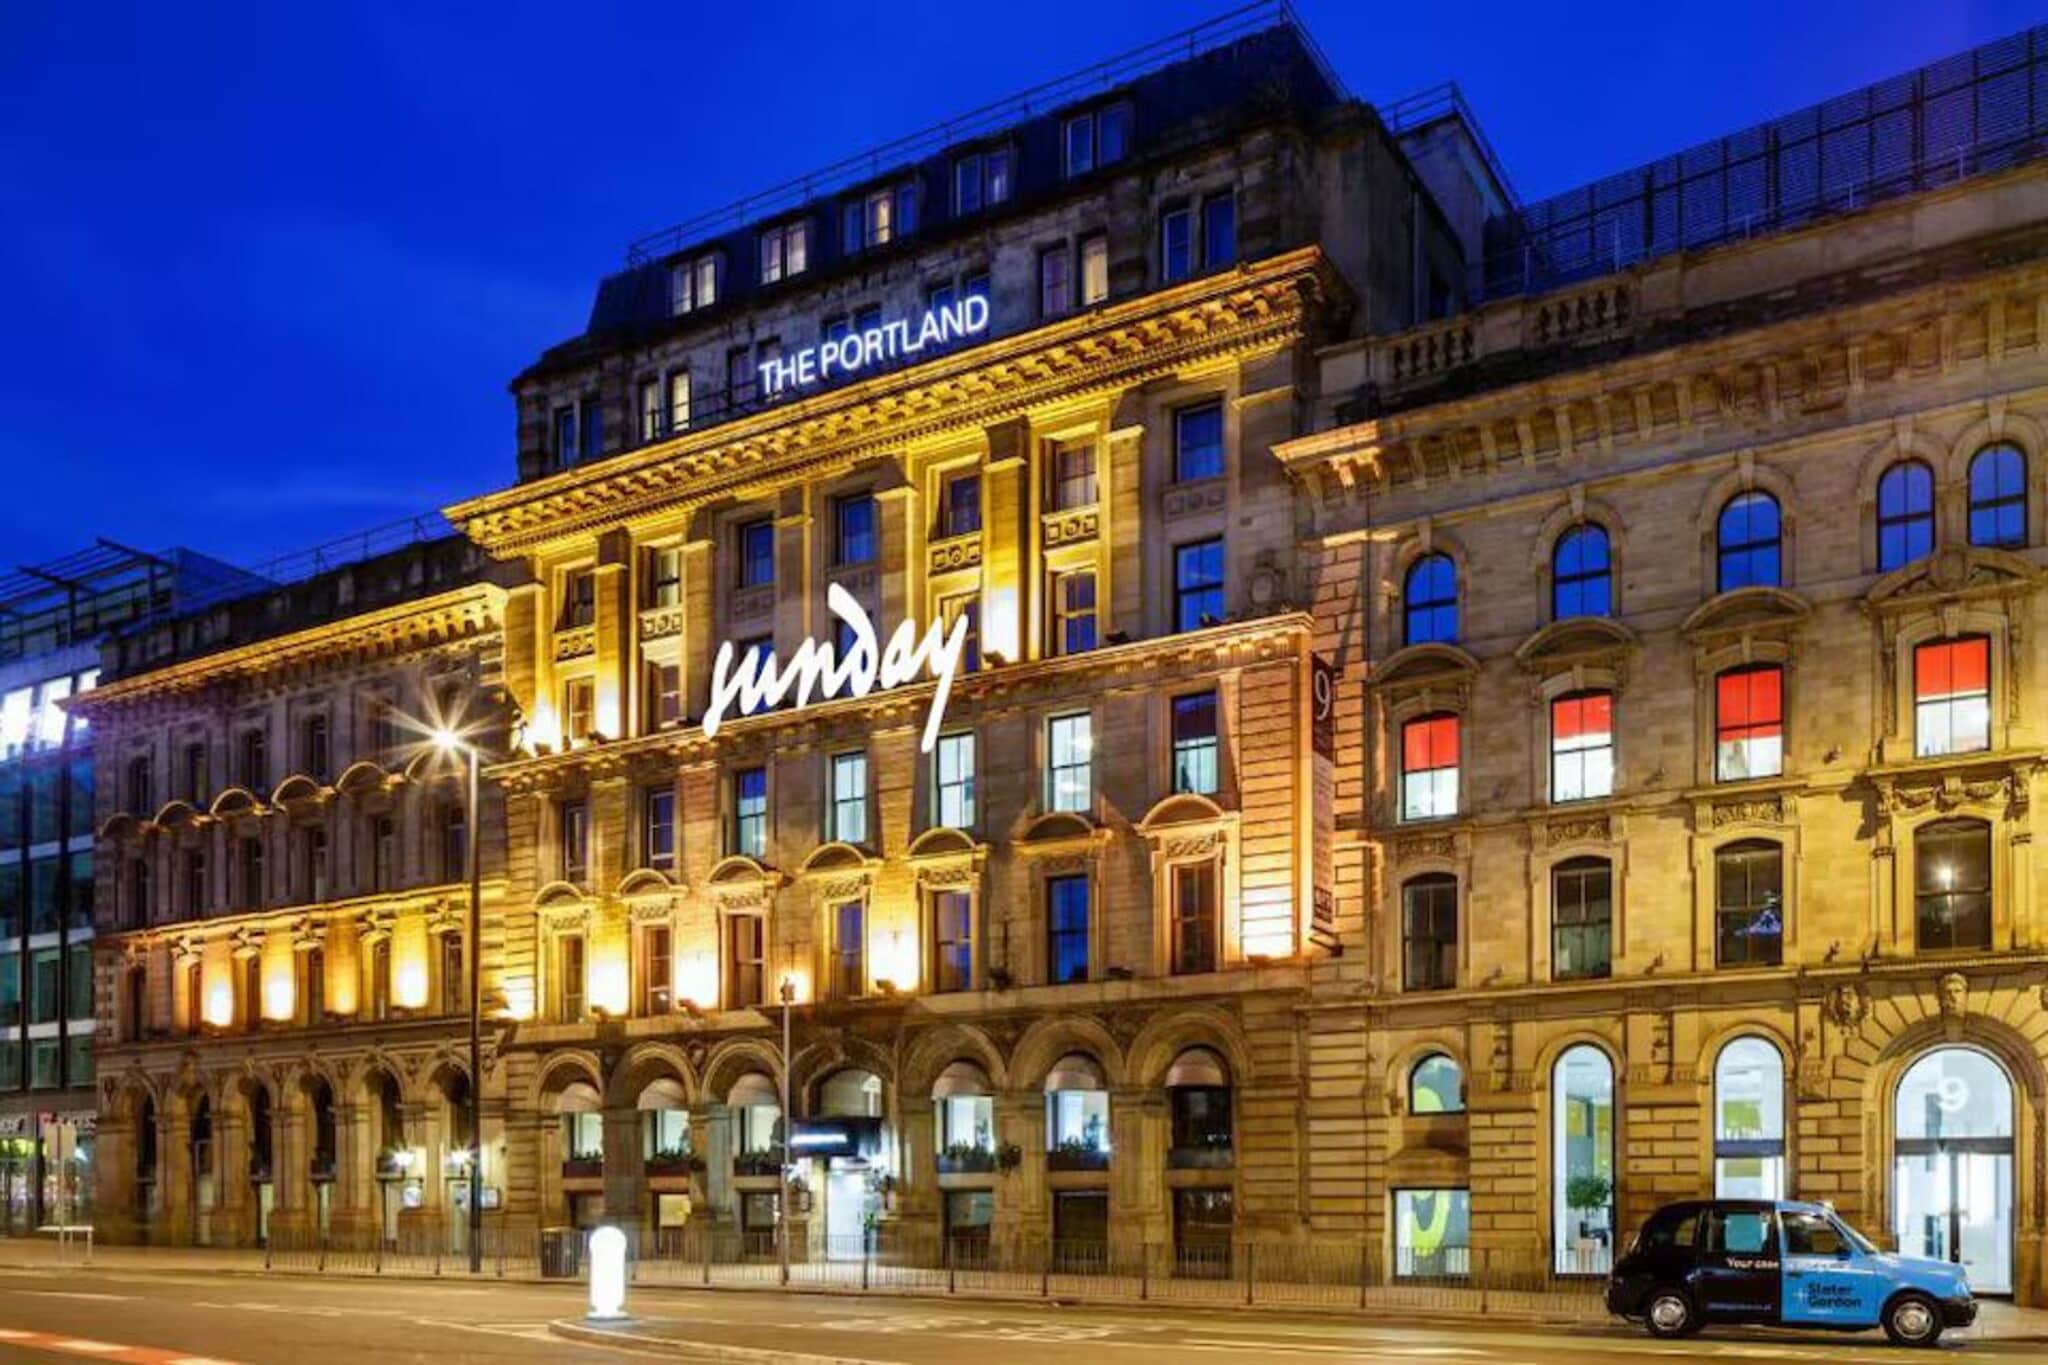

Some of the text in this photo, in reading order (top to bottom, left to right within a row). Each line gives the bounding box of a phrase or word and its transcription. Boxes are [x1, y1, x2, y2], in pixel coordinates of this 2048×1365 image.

[758, 294, 990, 395] THE PORTLAND
[1314, 669, 1331, 721] 9
[1937, 1076, 1970, 1112] 9
[1726, 1257, 1752, 1269] Your
[1807, 1296, 1862, 1309] Gordon
